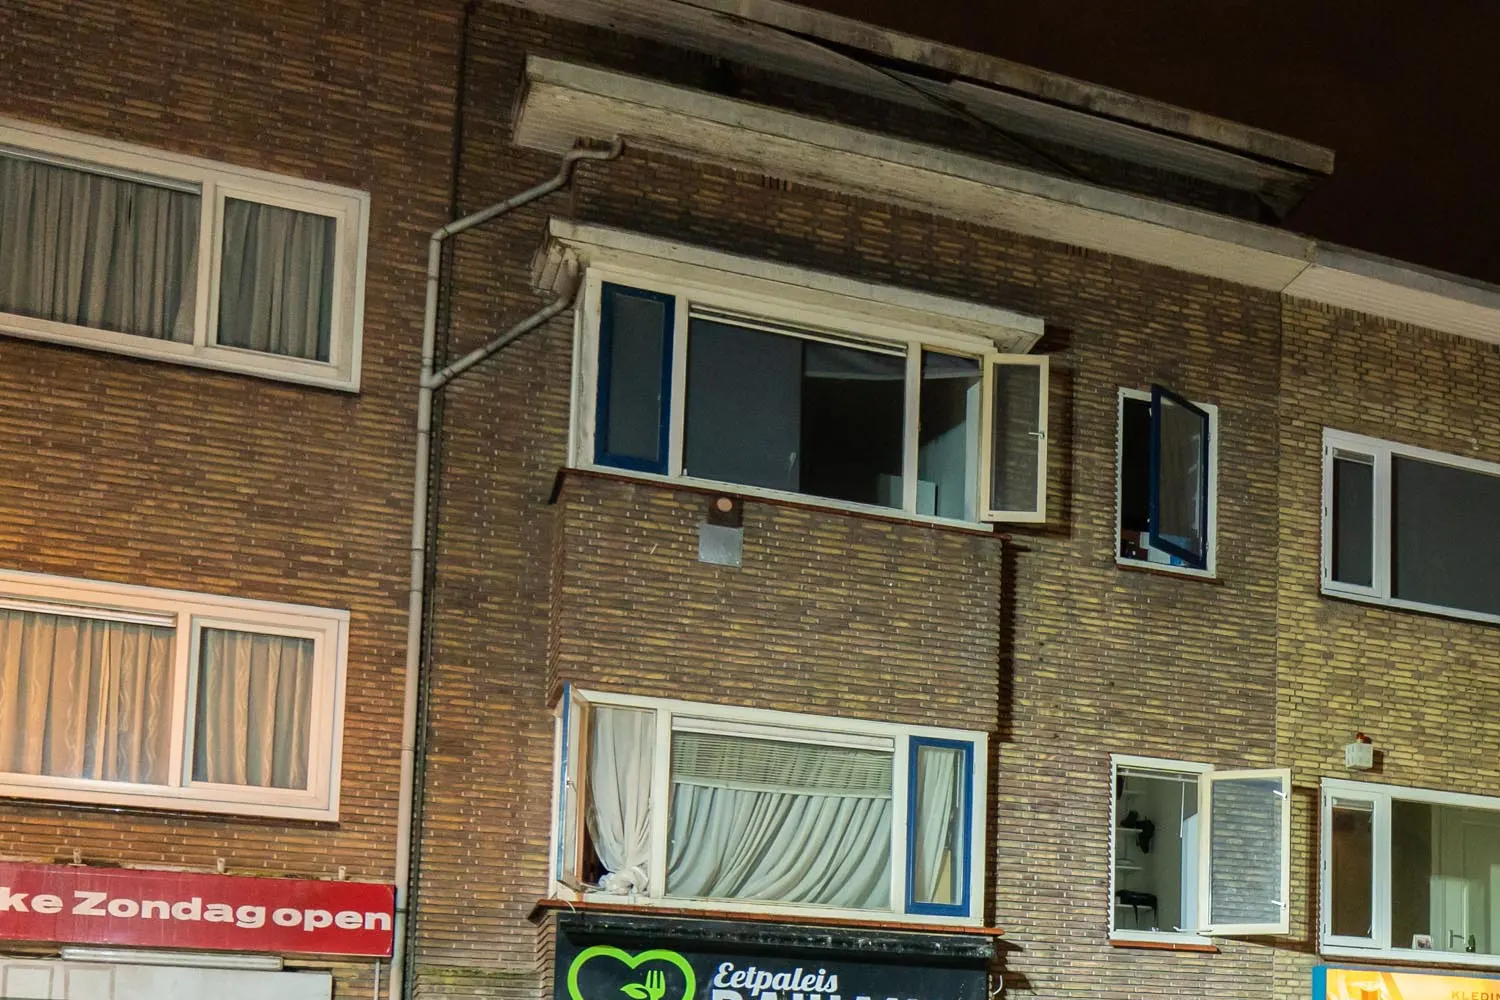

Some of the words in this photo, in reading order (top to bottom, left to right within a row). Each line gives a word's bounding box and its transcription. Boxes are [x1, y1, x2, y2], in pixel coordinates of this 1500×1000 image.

[72, 890, 266, 928] Zondag
[273, 907, 391, 932] open
[713, 962, 838, 996] Eetpaleis
